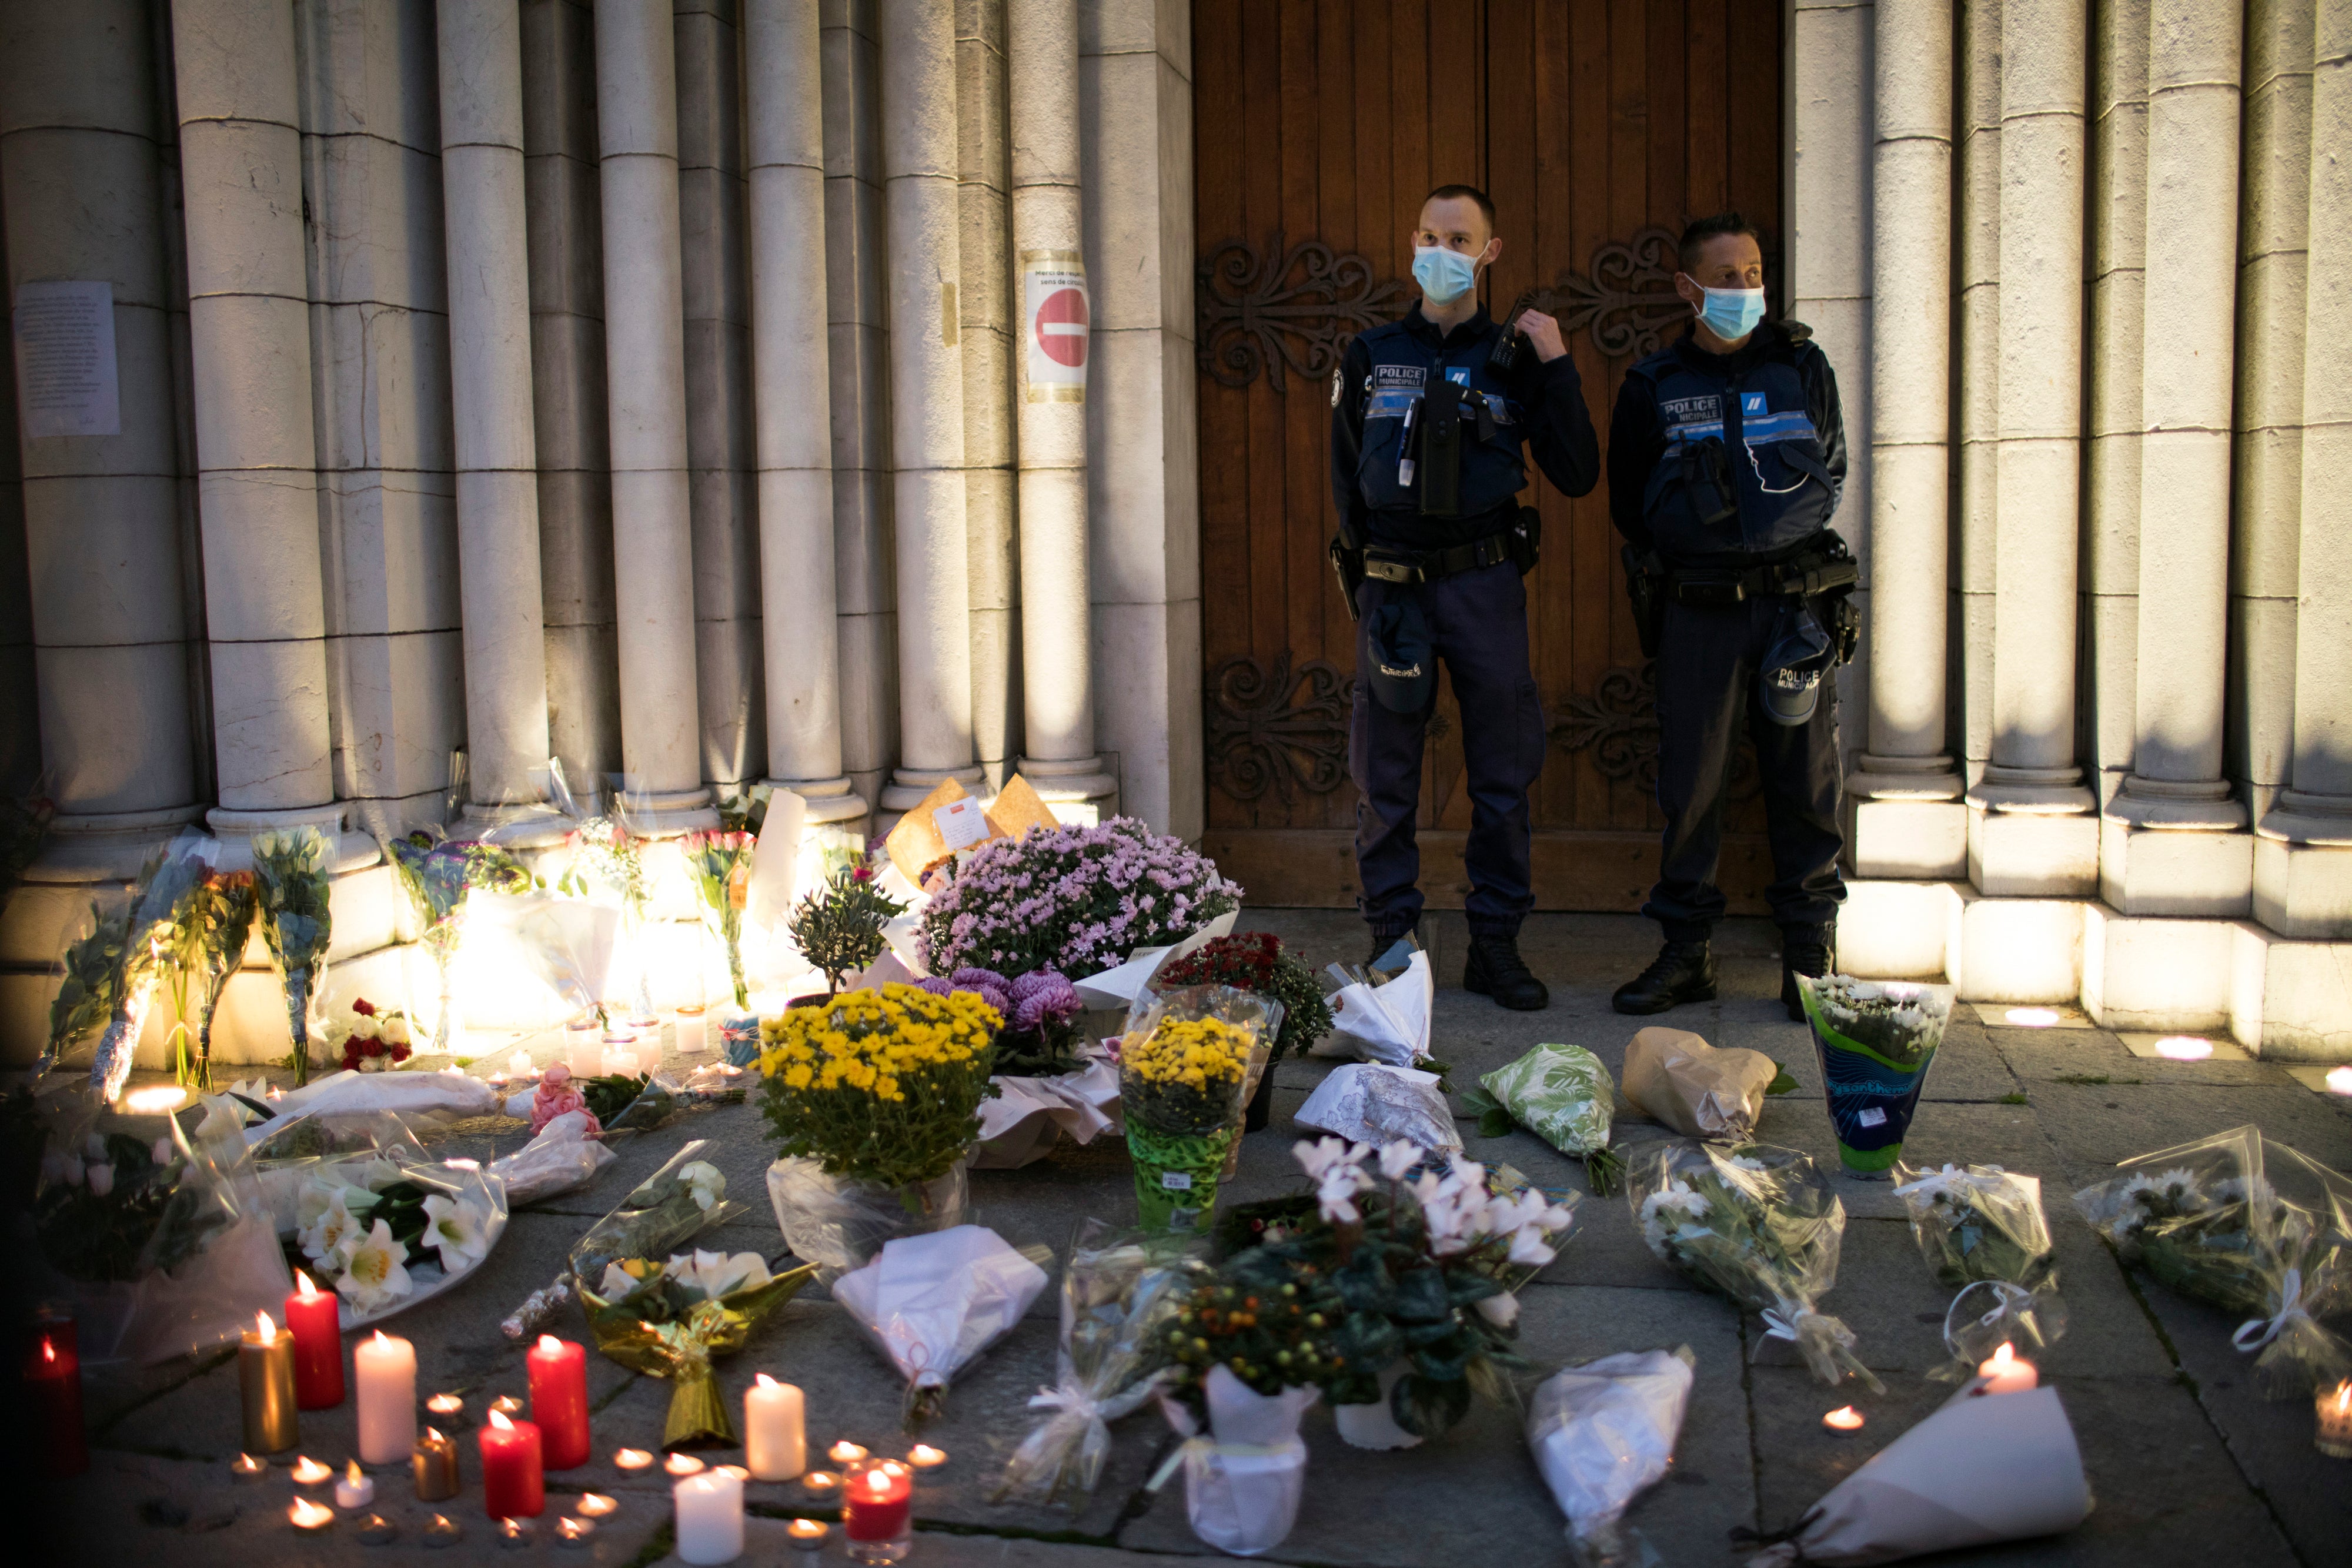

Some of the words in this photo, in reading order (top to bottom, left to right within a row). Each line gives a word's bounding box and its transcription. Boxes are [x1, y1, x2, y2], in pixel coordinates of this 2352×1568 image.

[1379, 367, 1422, 379] POLICE
[1665, 399, 1717, 414] POLICE
[1779, 668, 1819, 683] POLICE
